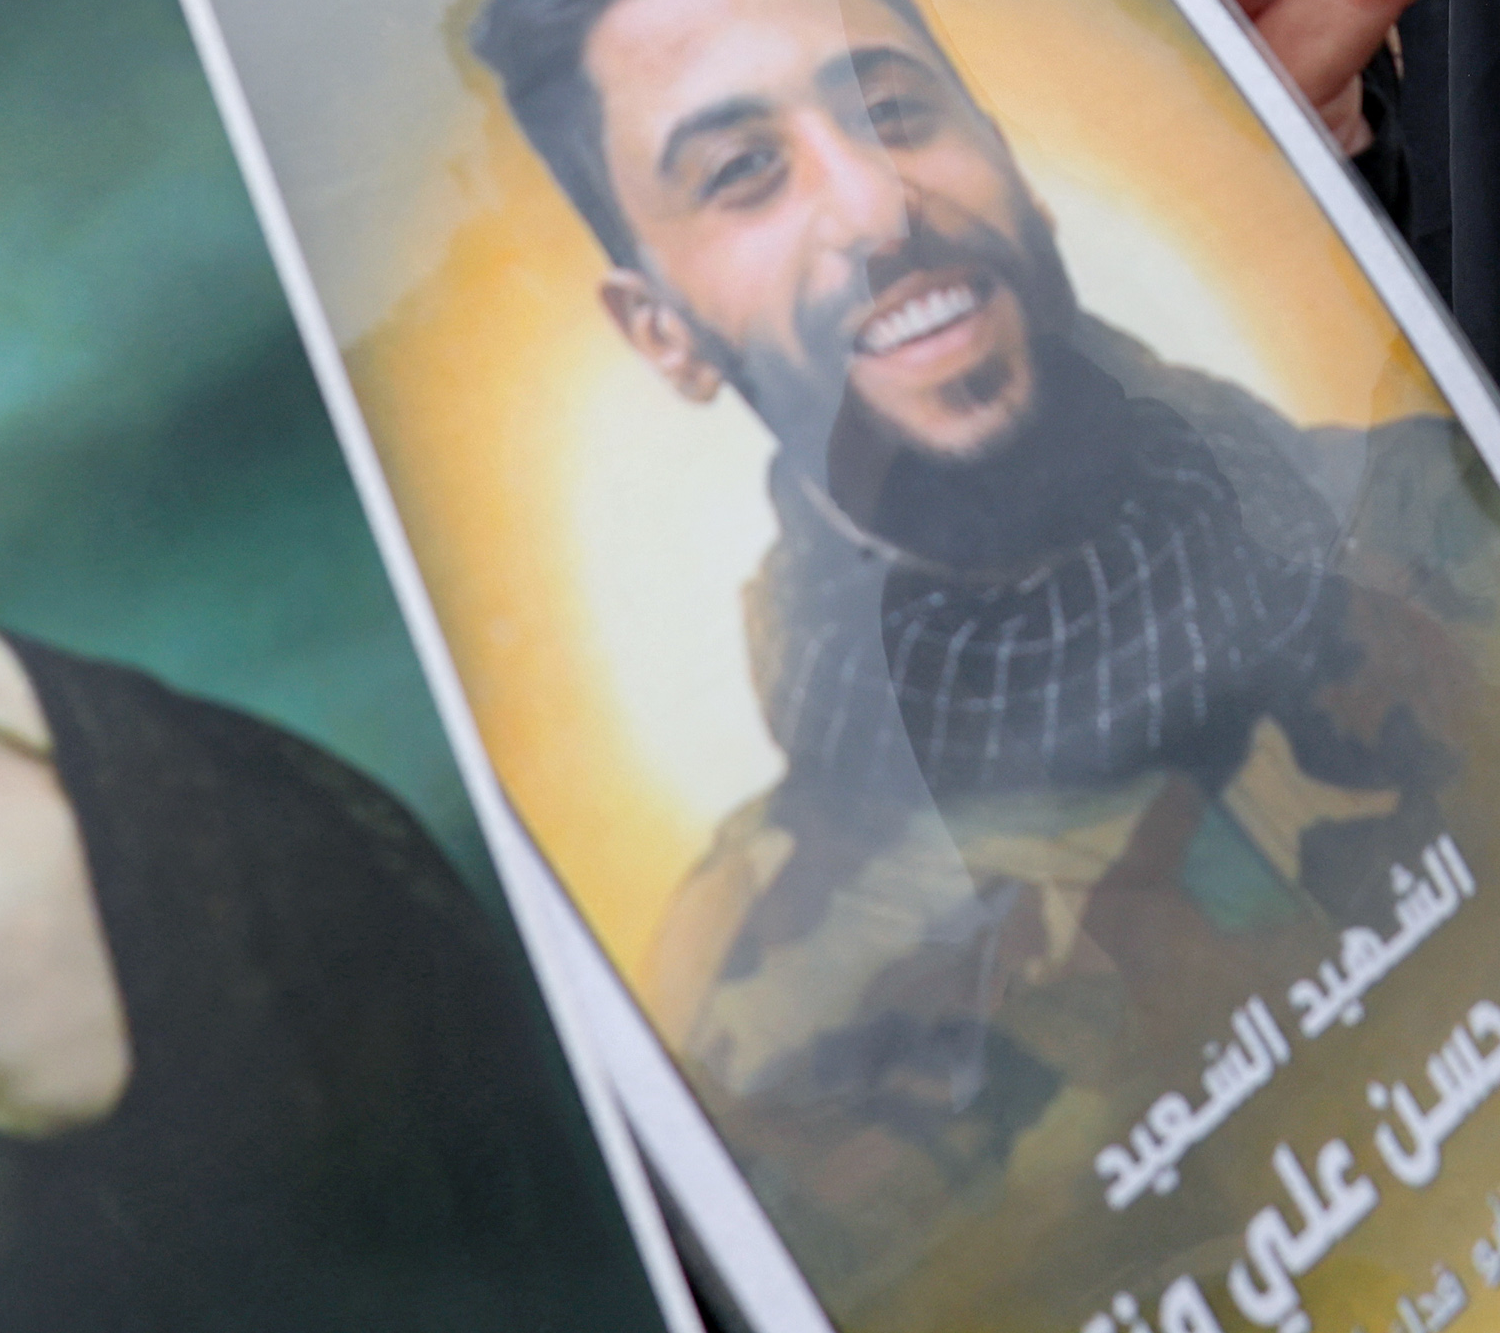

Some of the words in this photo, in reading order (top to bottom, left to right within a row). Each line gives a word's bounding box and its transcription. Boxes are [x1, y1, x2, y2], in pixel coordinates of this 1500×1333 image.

[1288, 833, 1477, 1039] الشهيد
[1094, 994, 1292, 1210] السعيد
[1227, 1139, 1381, 1333] علي
